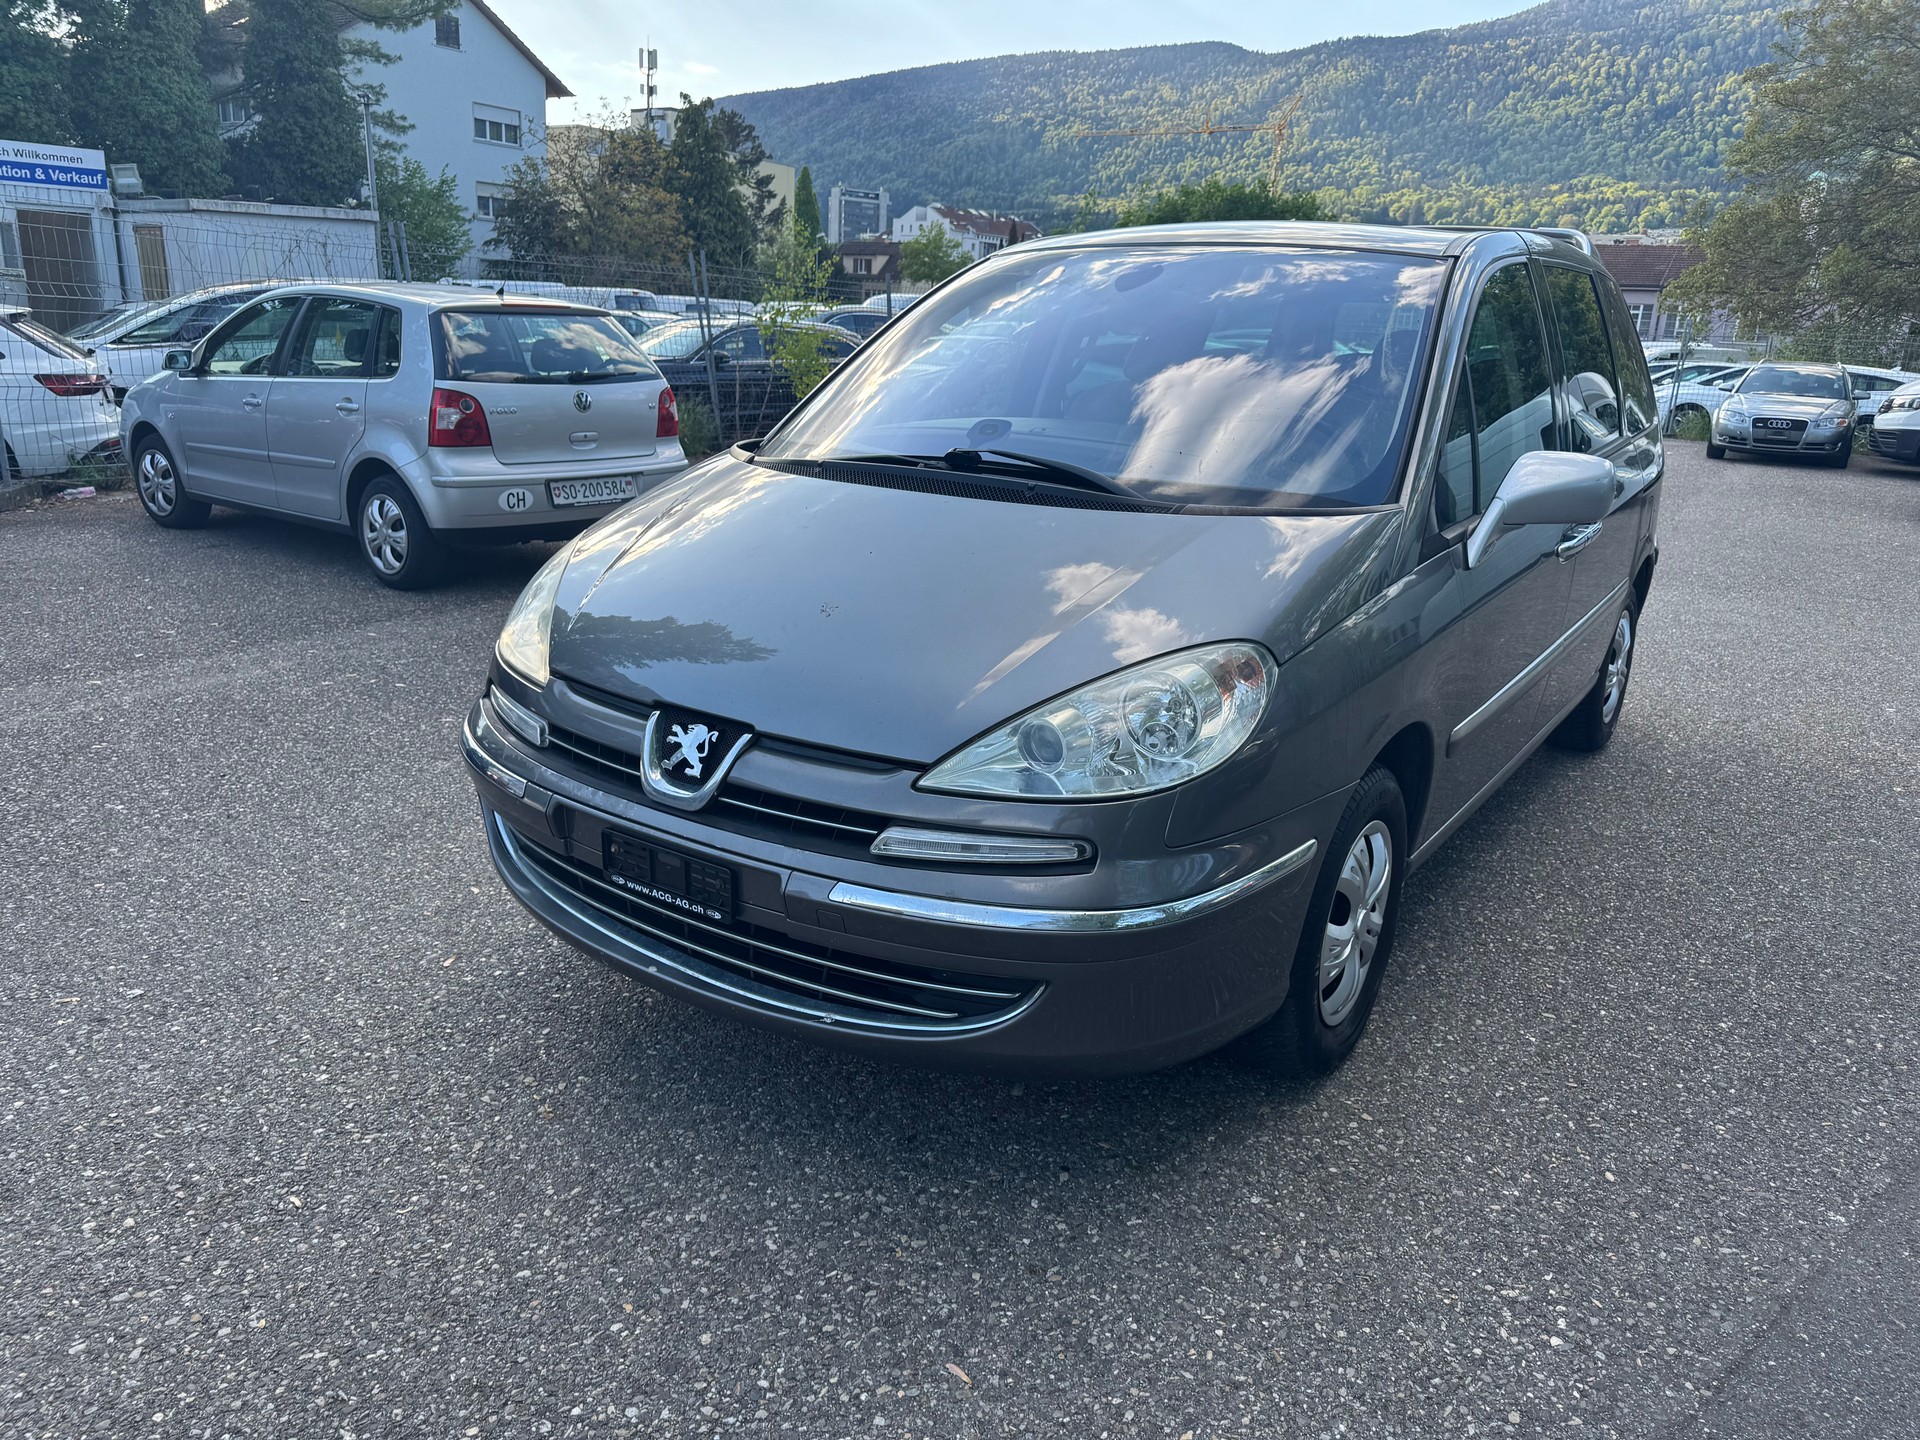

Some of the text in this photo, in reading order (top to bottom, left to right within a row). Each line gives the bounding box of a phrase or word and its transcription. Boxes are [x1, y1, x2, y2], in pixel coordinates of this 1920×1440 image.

[0, 147, 83, 164] h Willkommen
[34, 167, 46, 180] &
[49, 169, 102, 184] Verkauf
[489, 407, 518, 415] POLO
[506, 491, 526, 509] CH
[626, 880, 704, 914] www.ACG-AG.ch
